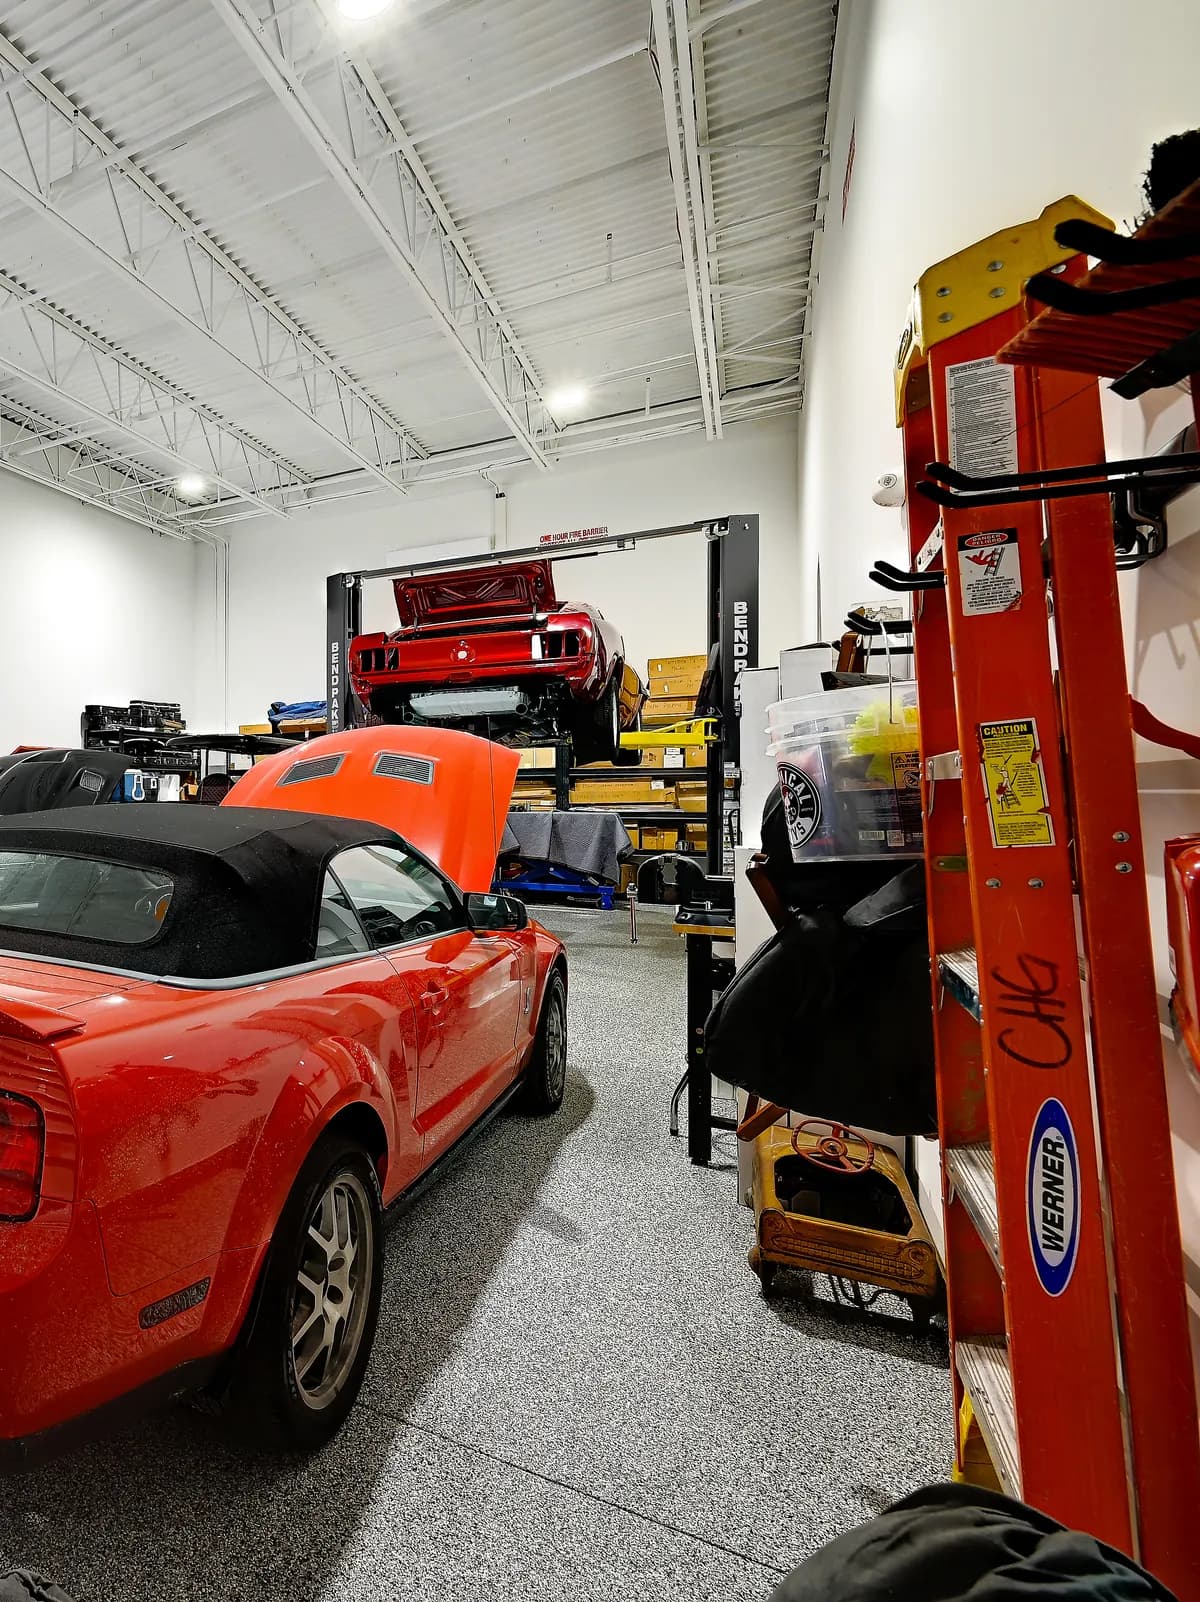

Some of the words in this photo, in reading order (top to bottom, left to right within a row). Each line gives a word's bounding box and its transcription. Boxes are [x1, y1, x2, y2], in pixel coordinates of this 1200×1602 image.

[540, 535, 552, 543] ONE
[552, 532, 568, 542] HOUR
[569, 529, 582, 539] FIRE
[582, 526, 608, 537] BARRIER
[972, 534, 1001, 542] DANGER
[331, 642, 339, 719] BENDPAK
[983, 723, 1028, 735] CAUTION
[1041, 1137, 1065, 1252] WERNER
